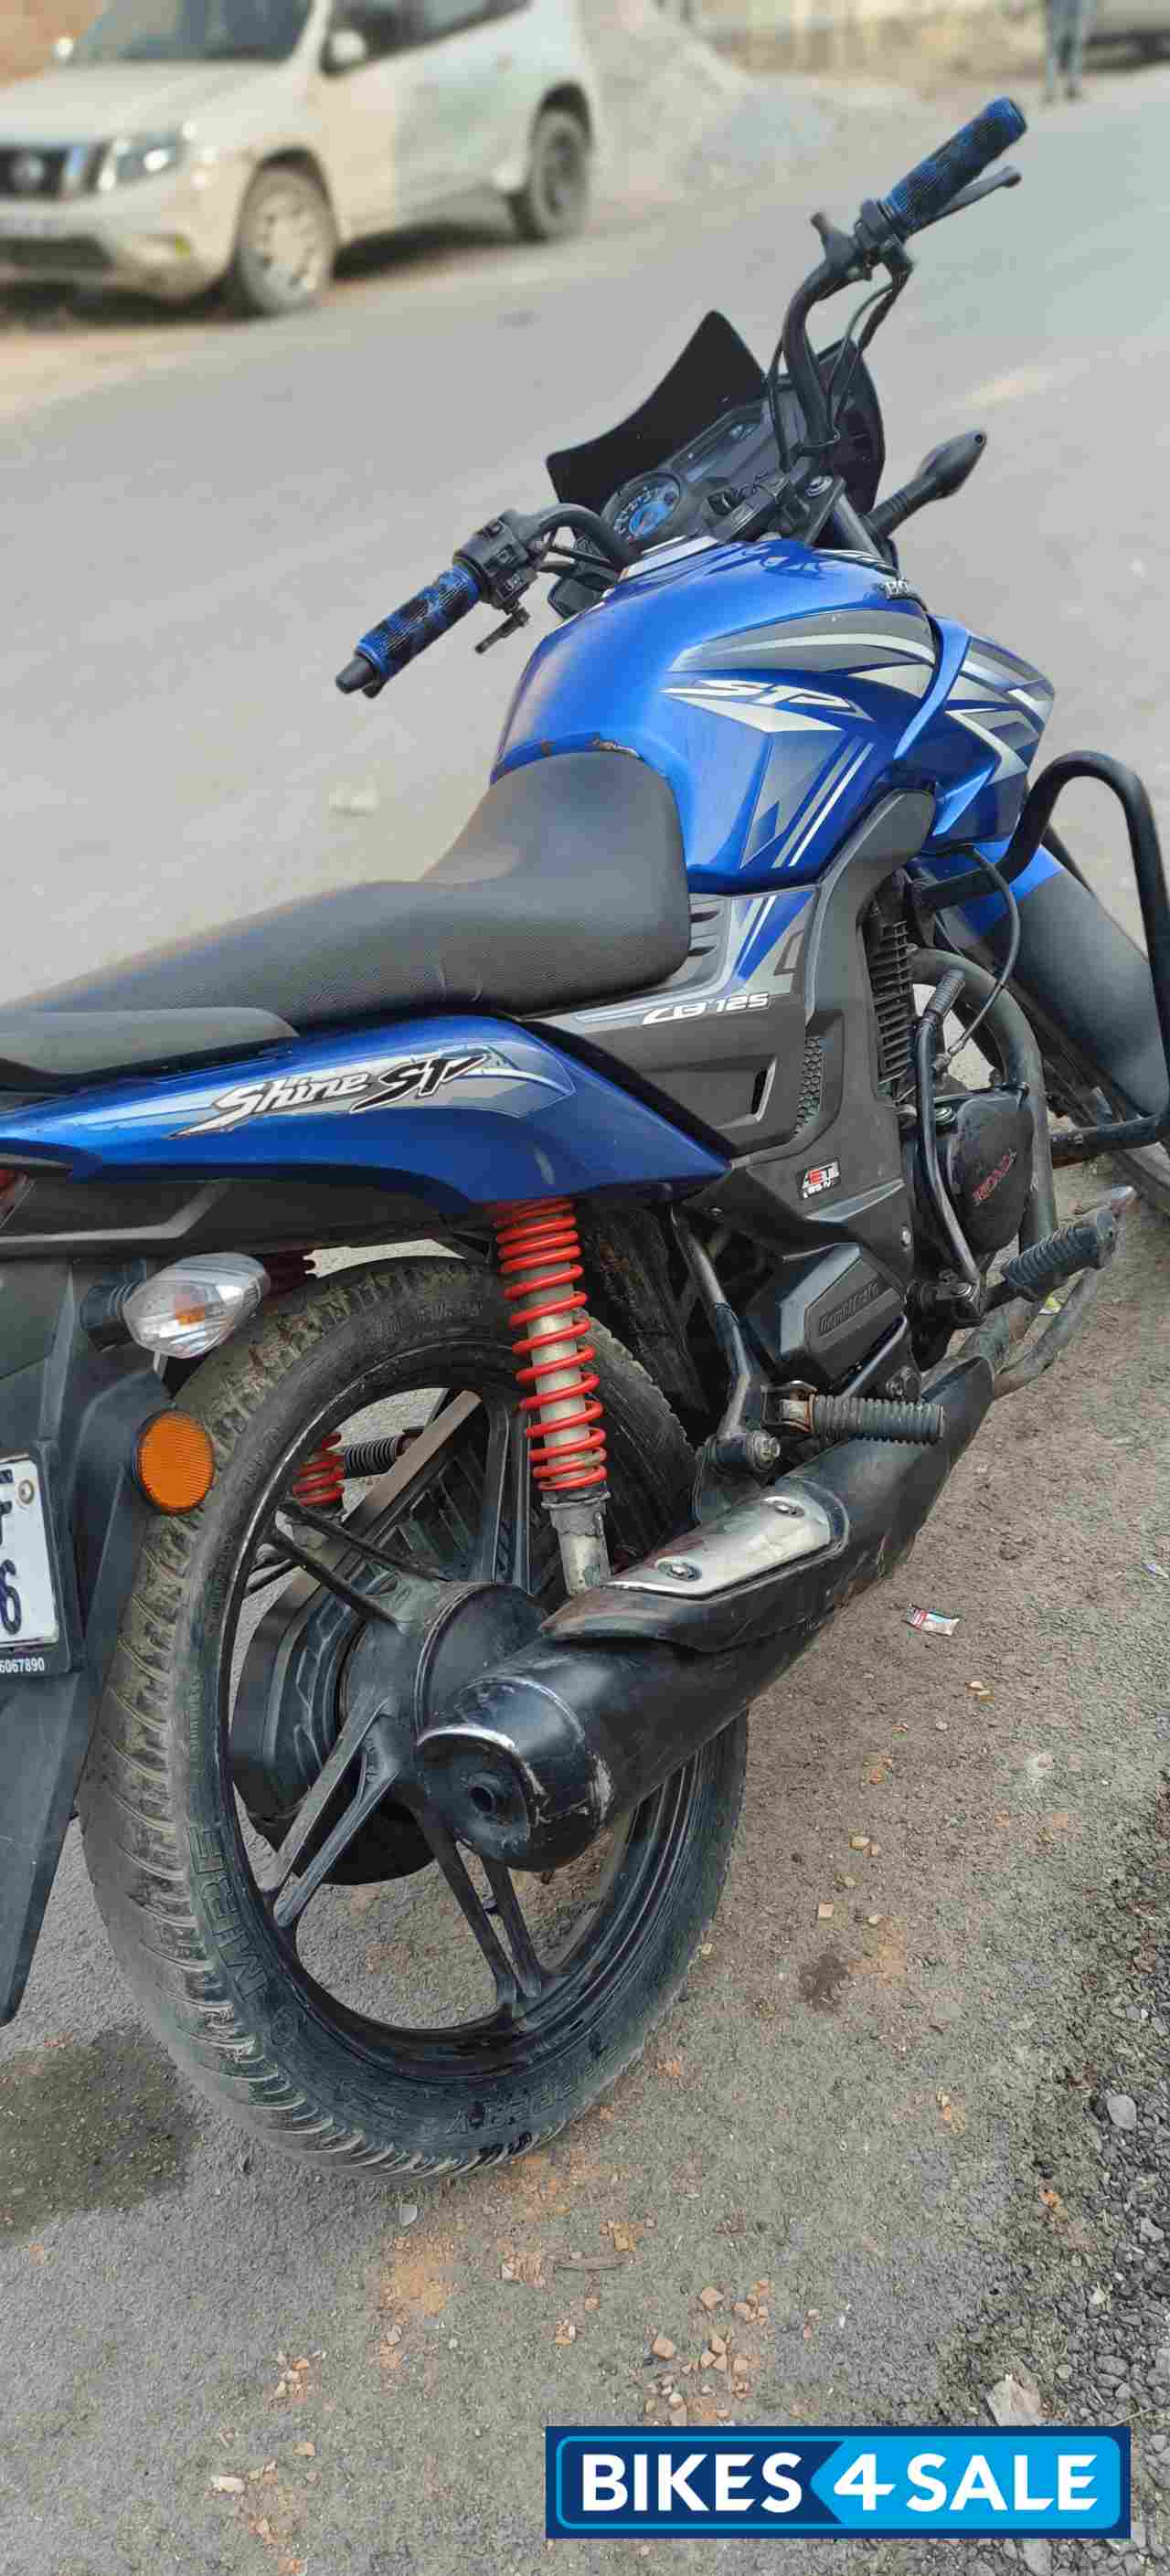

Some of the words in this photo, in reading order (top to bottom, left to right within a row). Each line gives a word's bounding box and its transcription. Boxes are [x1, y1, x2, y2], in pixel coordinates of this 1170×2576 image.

[716, 991, 770, 1014] 125
[167, 1072, 370, 1140] Shine
[186, 1823, 270, 2001] MRF
